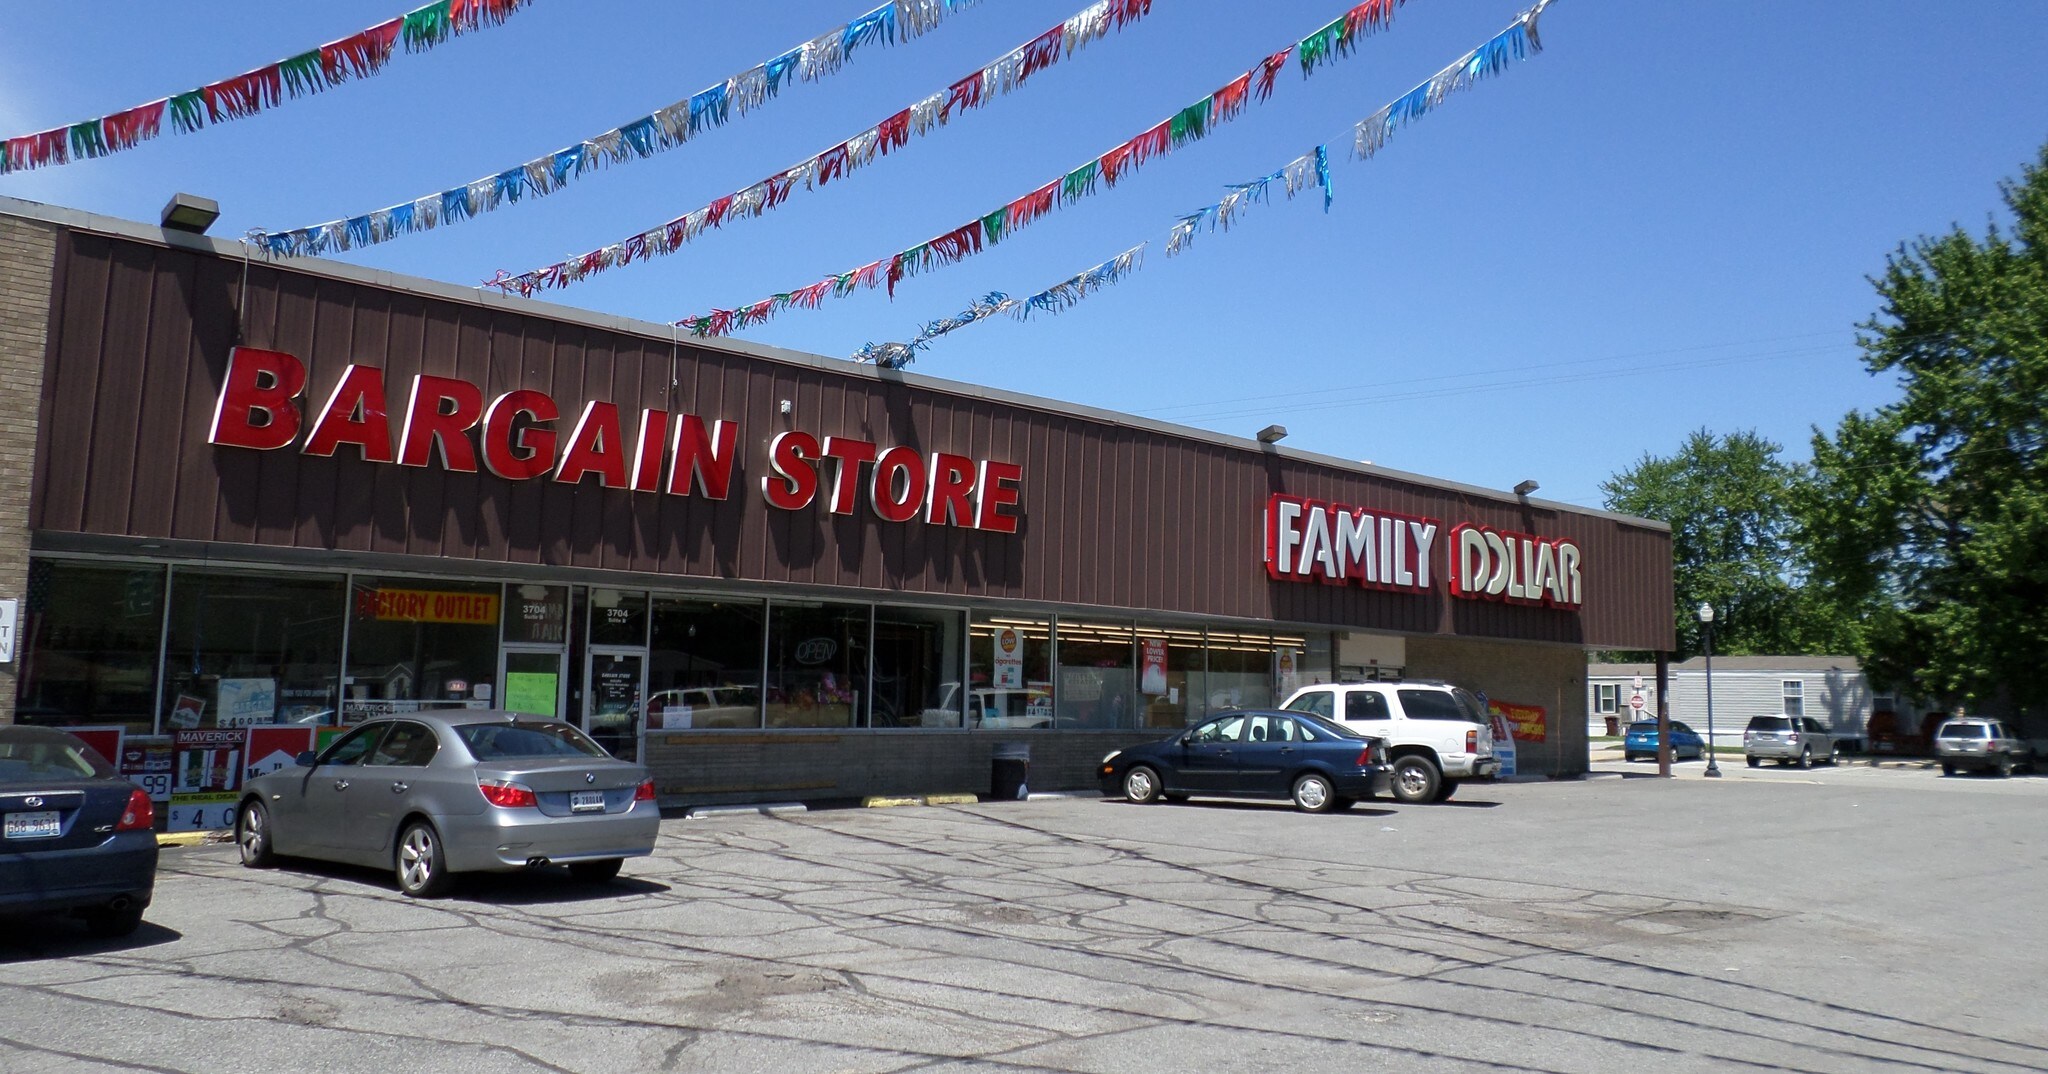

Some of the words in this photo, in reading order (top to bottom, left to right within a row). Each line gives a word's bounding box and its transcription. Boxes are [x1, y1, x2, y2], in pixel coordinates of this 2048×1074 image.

[208, 346, 738, 500] BARGAIN
[761, 430, 1023, 533] STORE
[1278, 501, 1437, 588] FAMILY
[1461, 528, 1582, 604] DOLLAR
[356, 591, 428, 618] FACTORY
[434, 593, 491, 620] OUTLET
[523, 605, 546, 614] 3704
[607, 609, 629, 618] 3704
[797, 642, 834, 659] OPEN
[1146, 647, 1165, 655] LOWER
[346, 702, 390, 712] MAVERICK
[179, 731, 244, 743] MAVERICK
[172, 794, 187, 802] THE
[191, 793, 213, 801] REAL
